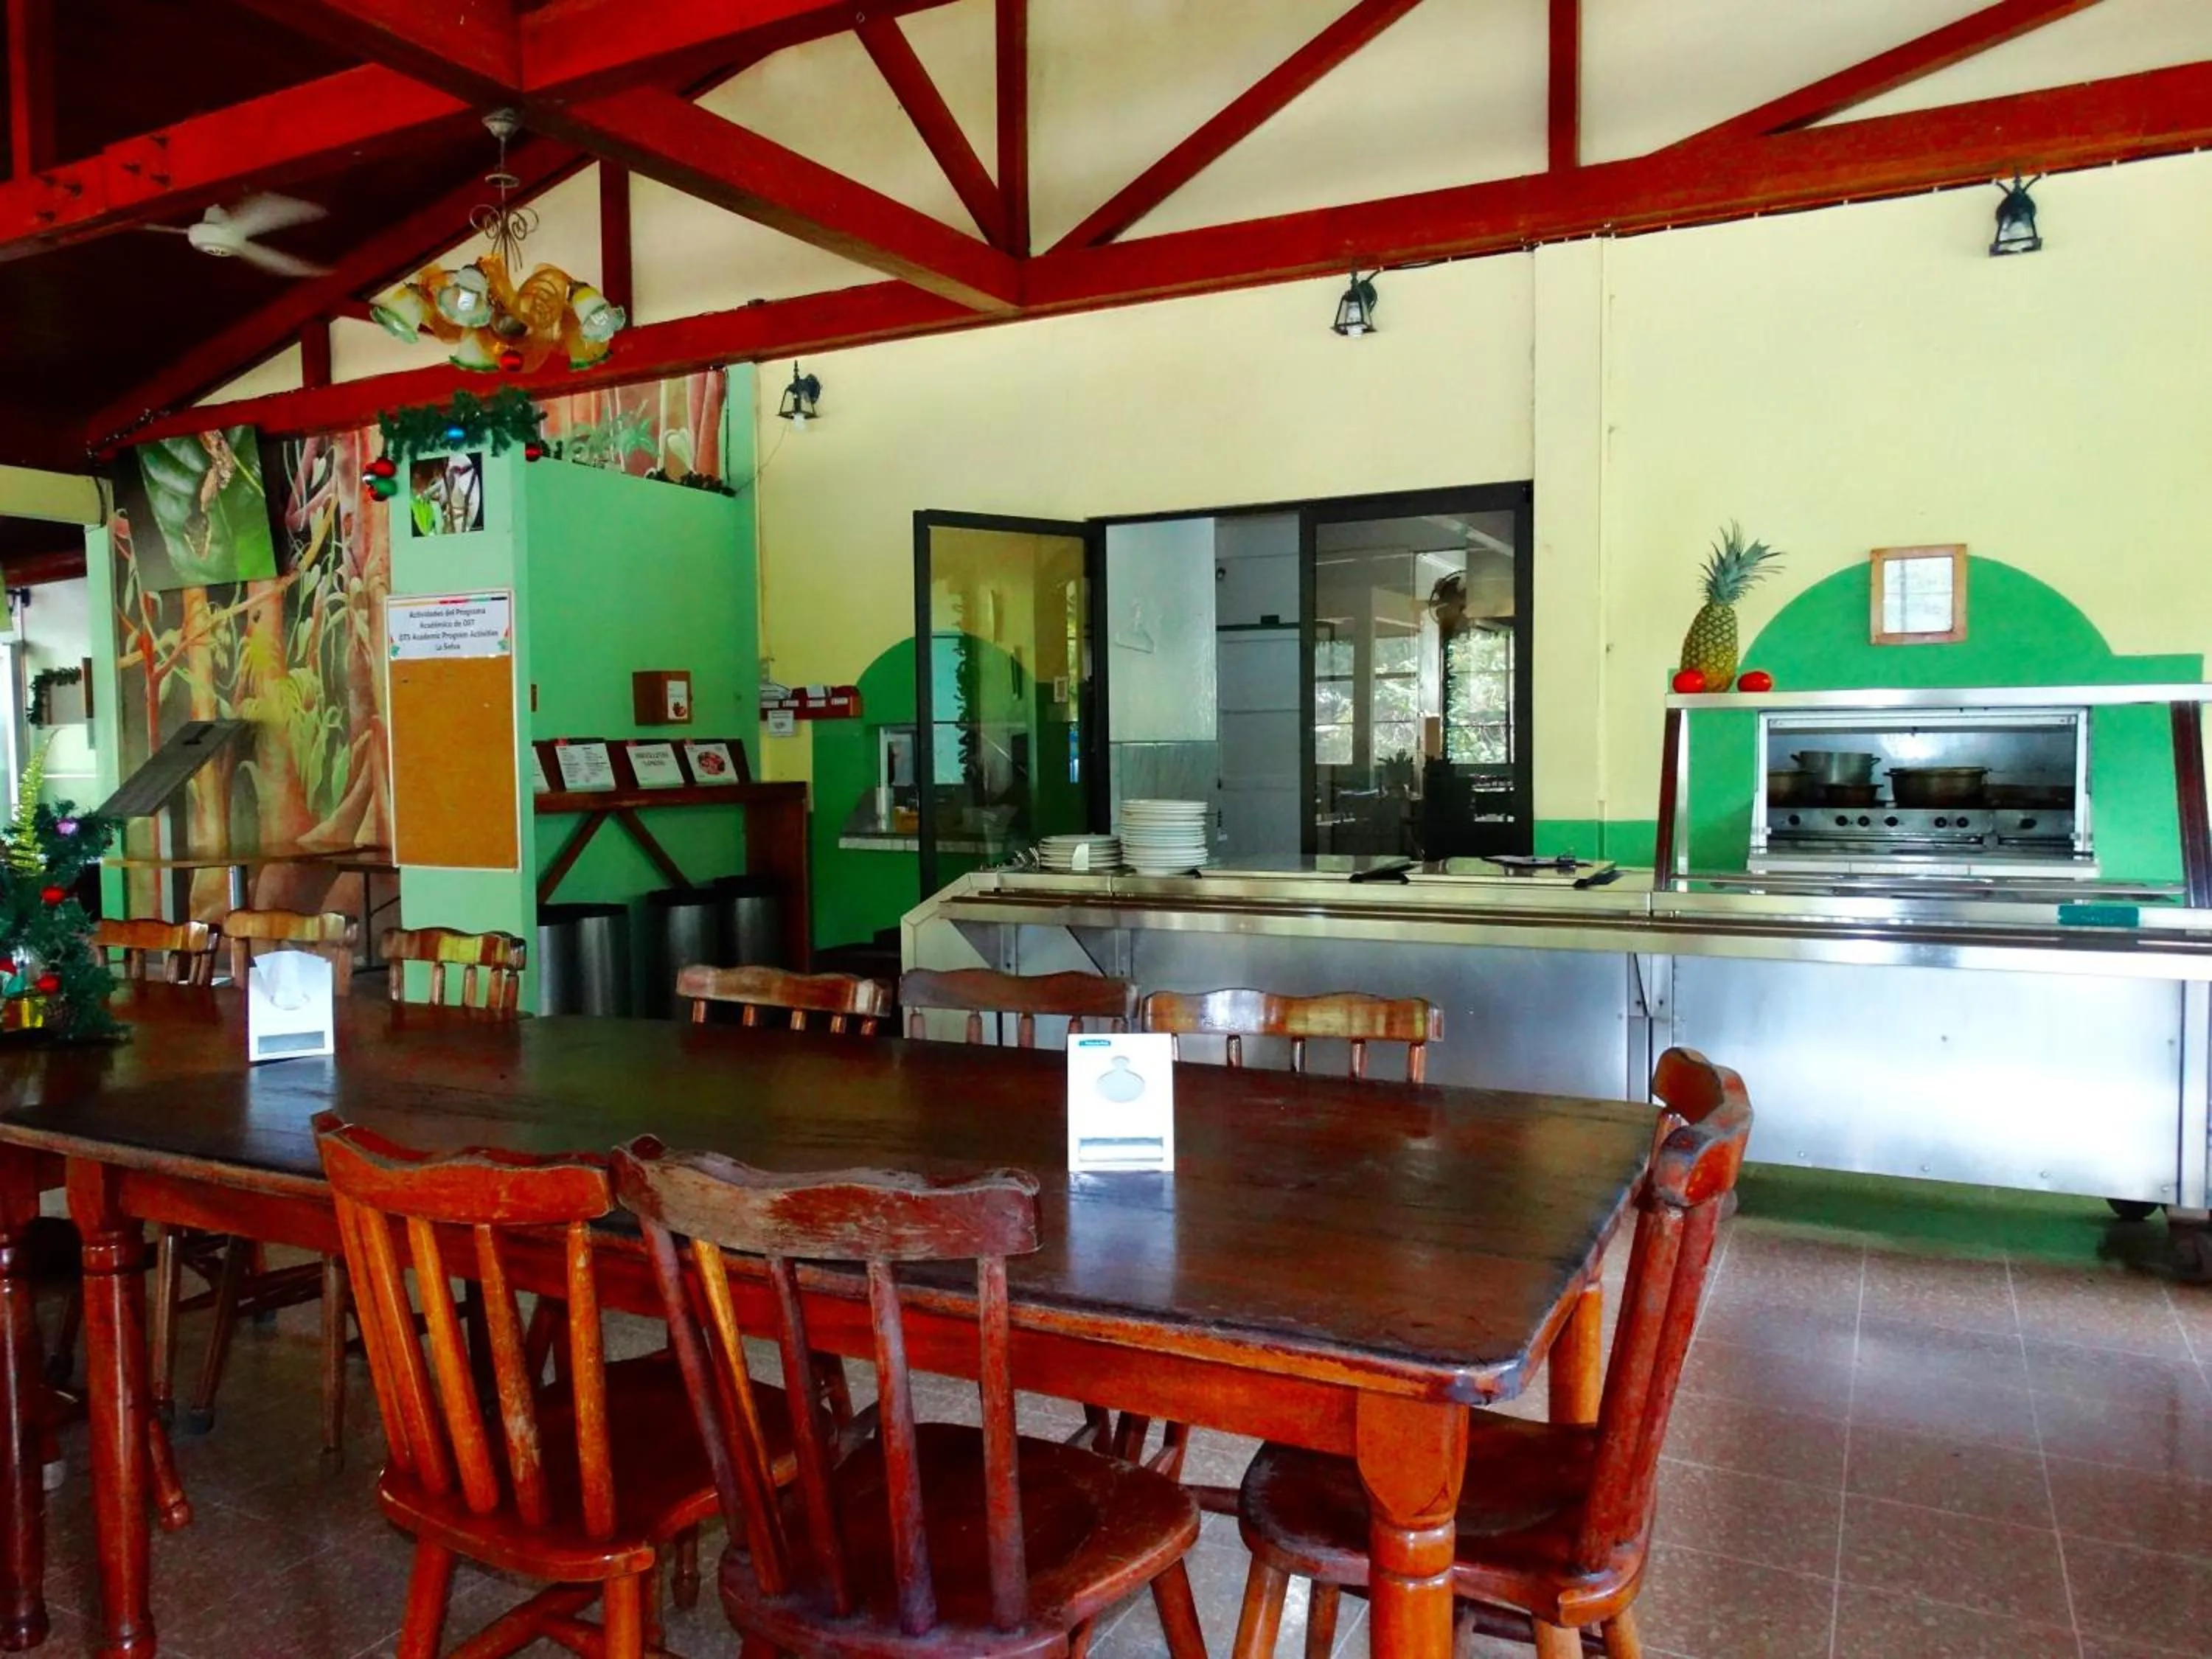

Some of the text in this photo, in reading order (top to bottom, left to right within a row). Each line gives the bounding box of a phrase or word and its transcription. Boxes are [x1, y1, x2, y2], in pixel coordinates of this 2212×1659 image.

[456, 608, 485, 616] Programa
[442, 631, 469, 640] Program
[443, 642, 461, 650] Selva
